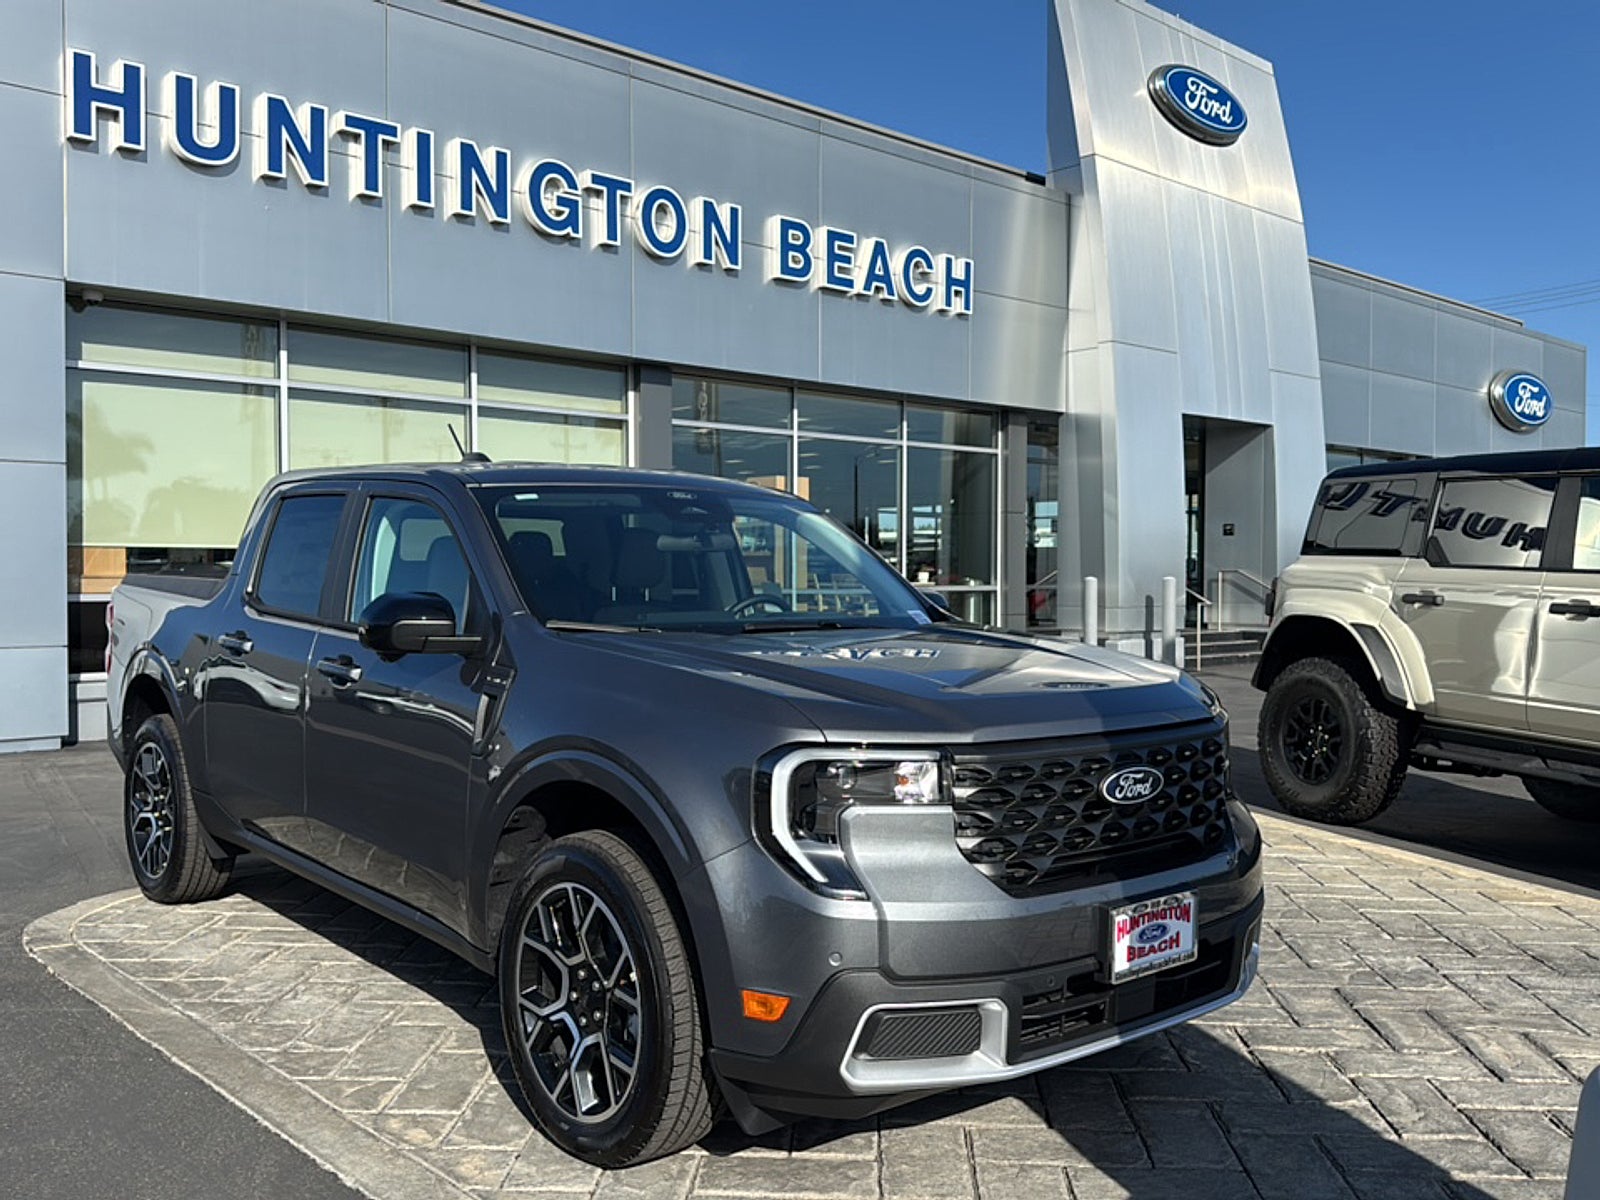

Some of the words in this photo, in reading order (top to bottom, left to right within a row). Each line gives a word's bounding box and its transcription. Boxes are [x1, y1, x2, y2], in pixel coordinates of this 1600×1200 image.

[1184, 76, 1233, 124] Ford
[67, 48, 742, 271] HUNTINGTON
[771, 214, 975, 315] BEACH
[1514, 381, 1547, 418] Ford
[1115, 772, 1153, 799] Ford
[1117, 901, 1192, 943] HUNTINGTON
[1126, 931, 1181, 963] BEACH
